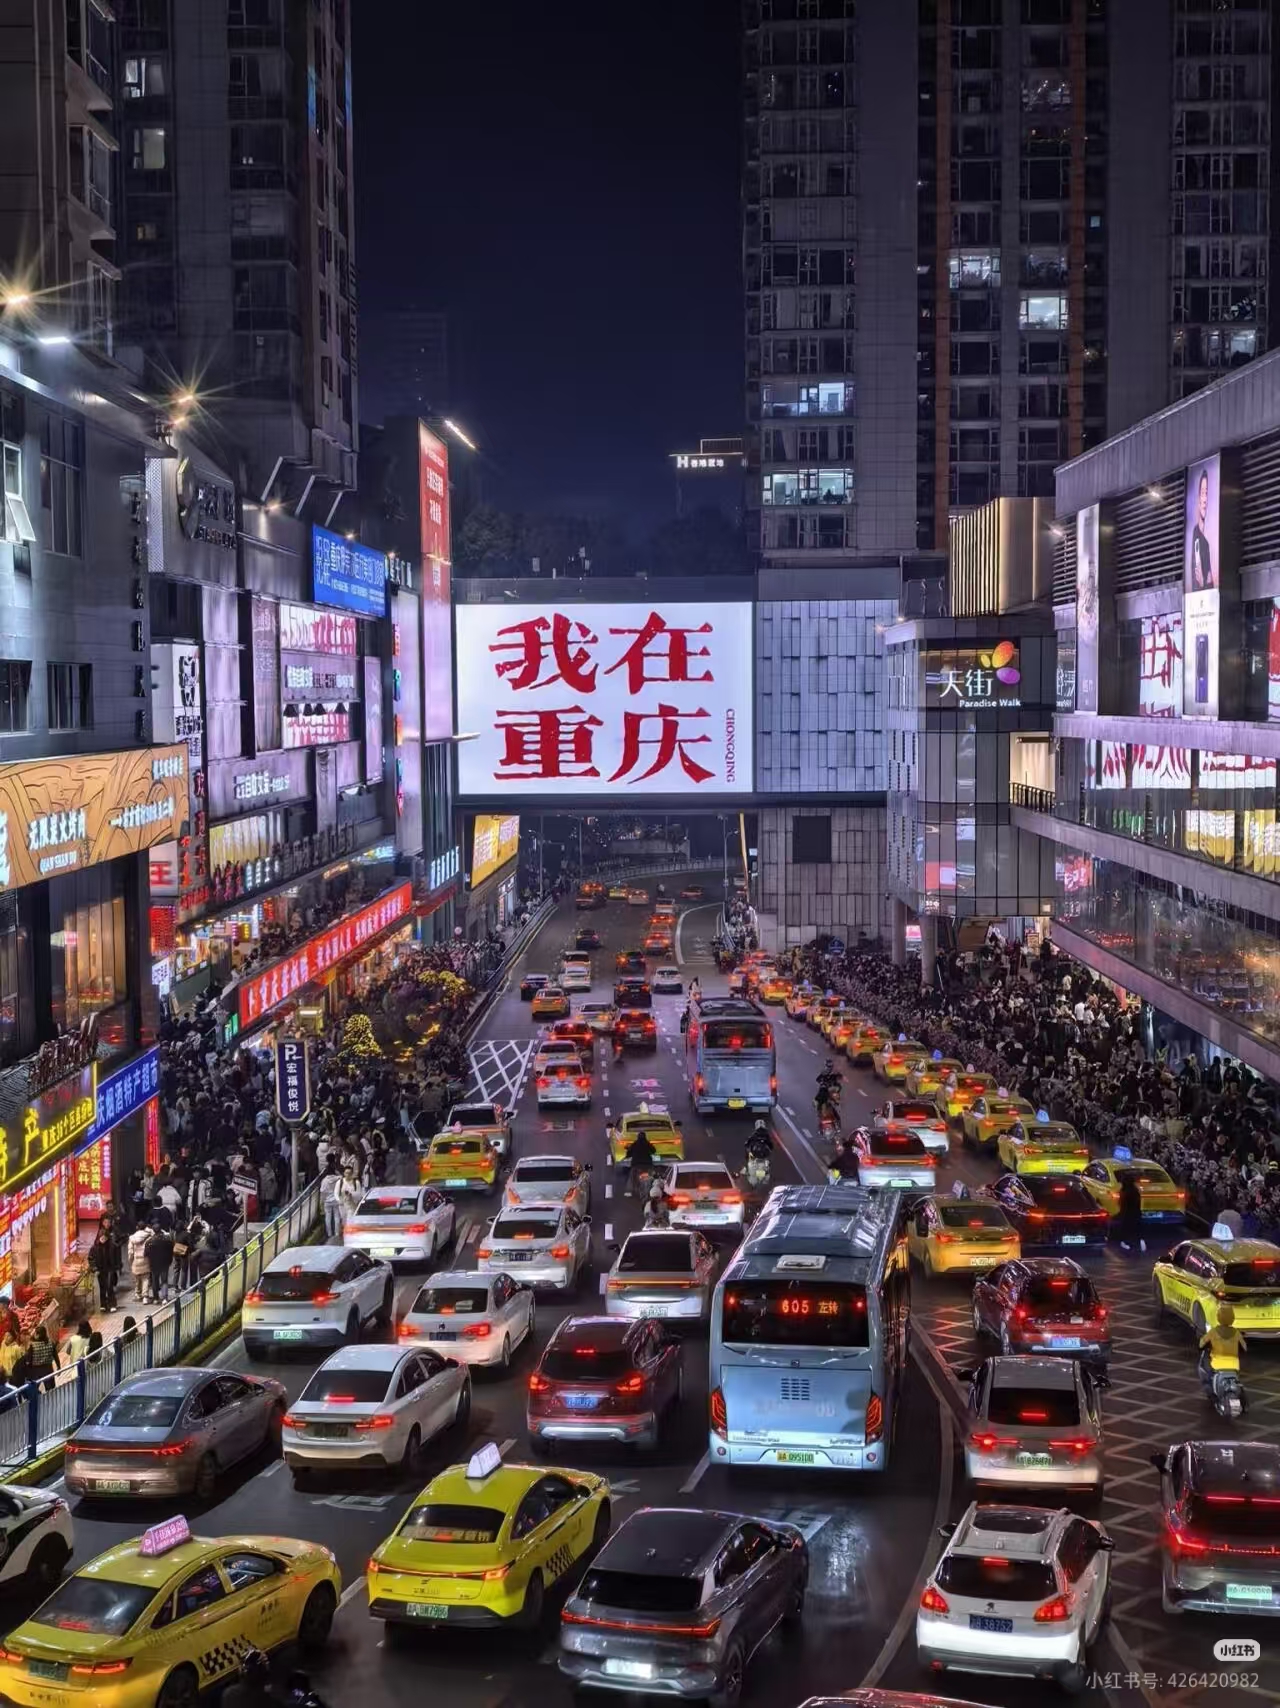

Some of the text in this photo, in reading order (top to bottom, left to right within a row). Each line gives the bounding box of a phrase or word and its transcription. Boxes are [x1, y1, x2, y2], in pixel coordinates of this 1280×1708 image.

[488, 611, 714, 695] 我在
[940, 669, 993, 697] 天街
[959, 698, 1021, 708] Paradise Walk
[493, 703, 716, 785] 重庆
[725, 708, 735, 783] CHONGQING
[284, 1044, 297, 1061] P
[87, 1058, 158, 1137] 庆烟酒特产超市
[781, 1299, 809, 1314] 605
